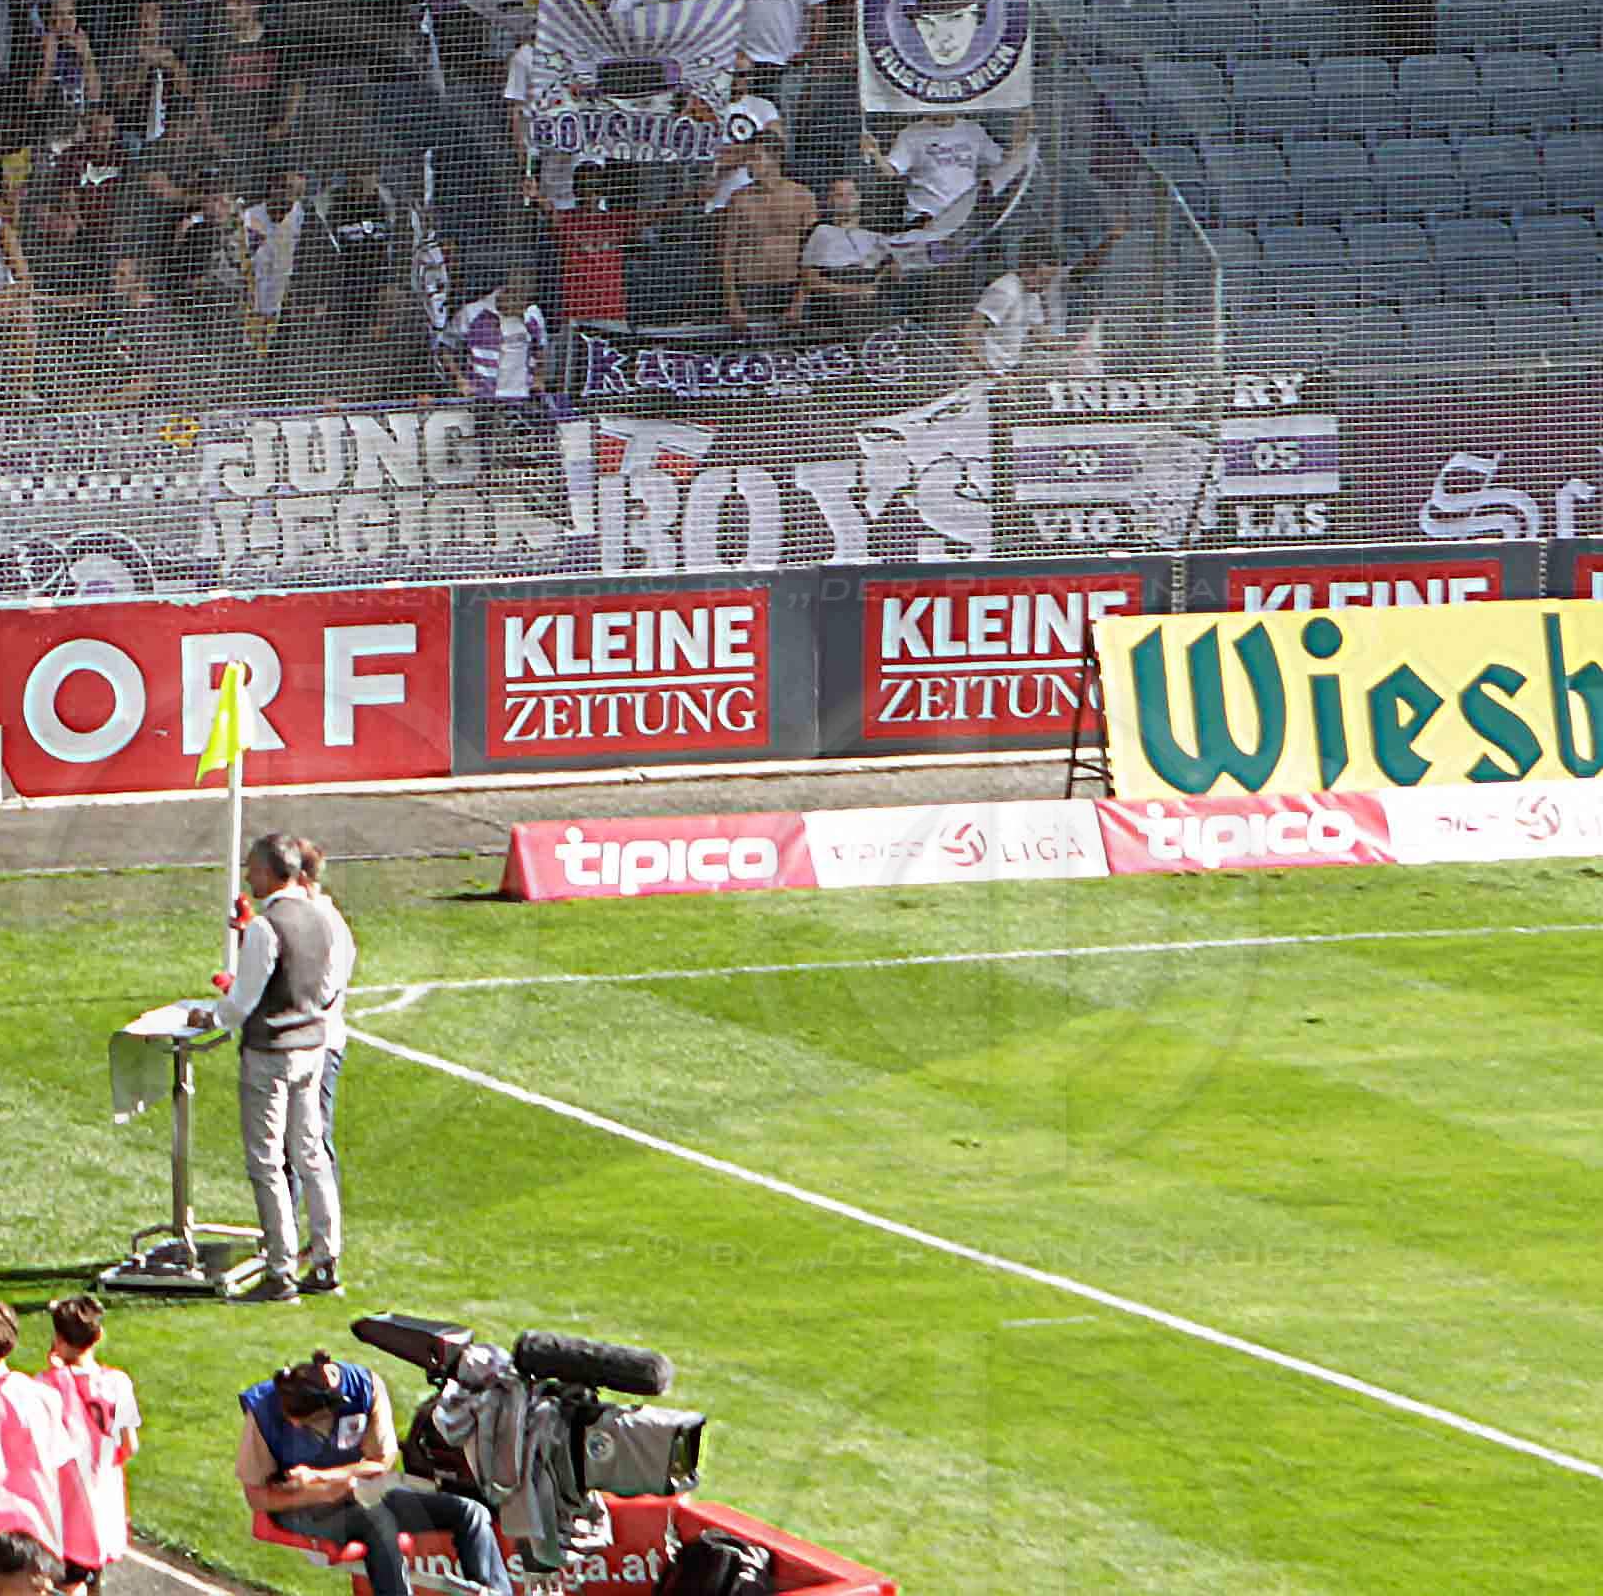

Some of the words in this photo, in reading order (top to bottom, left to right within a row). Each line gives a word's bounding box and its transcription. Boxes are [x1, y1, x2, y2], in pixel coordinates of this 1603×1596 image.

[502, 606, 756, 678] KLEINE
[23, 623, 418, 764] ORF
[502, 686, 758, 742] ZEITUNG
[878, 673, 1104, 725] ZEITUN
[555, 824, 780, 895] tipico
[1137, 804, 1357, 868] tipico
